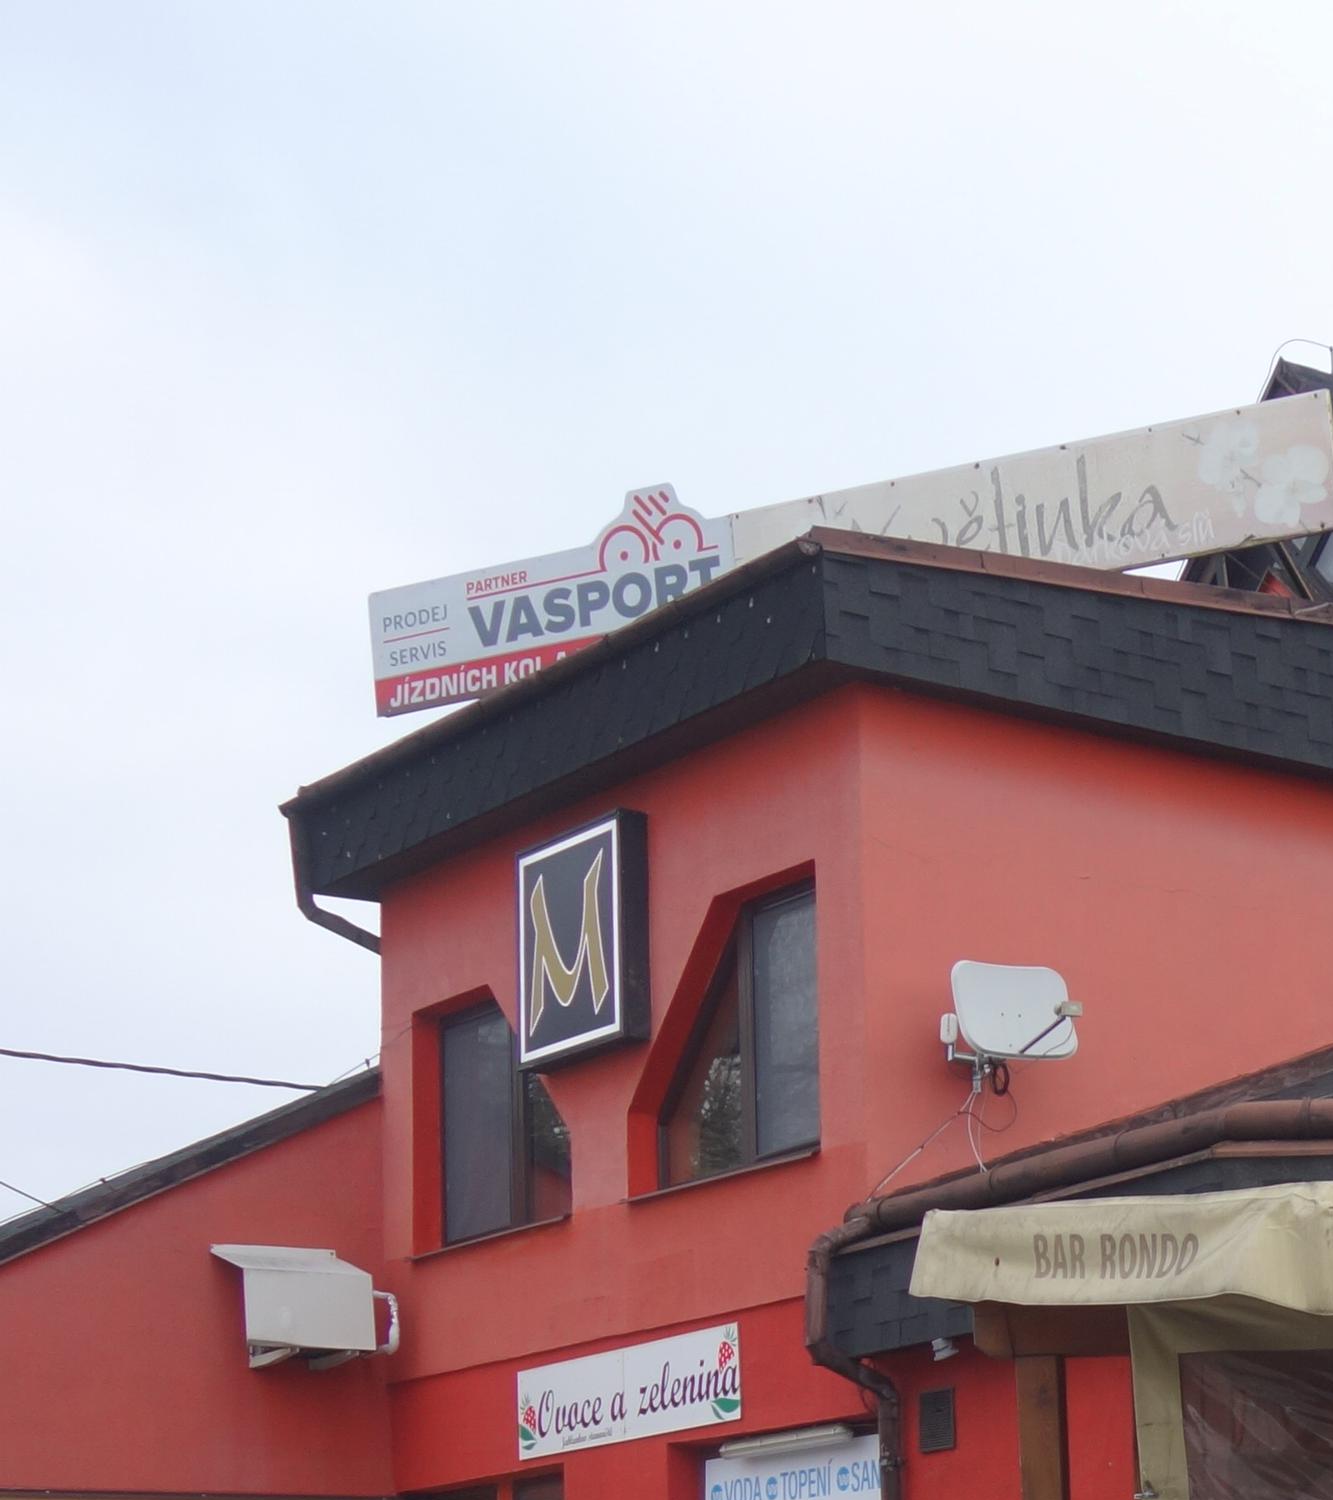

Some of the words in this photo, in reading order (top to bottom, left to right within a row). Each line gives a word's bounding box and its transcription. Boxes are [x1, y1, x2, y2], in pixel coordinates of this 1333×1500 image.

[466, 570, 528, 595] PARTNER
[467, 555, 721, 648] VASPORT
[382, 604, 448, 633] PRODEJ
[389, 641, 447, 667] SERVIS
[390, 665, 497, 707] JÍZDNÍCH
[1033, 1233, 1087, 1280] BAR
[1100, 1232, 1199, 1279] RONDO
[538, 1390, 603, 1438] Ovoce
[611, 1391, 627, 1421] a
[638, 1360, 740, 1417] zelenina
